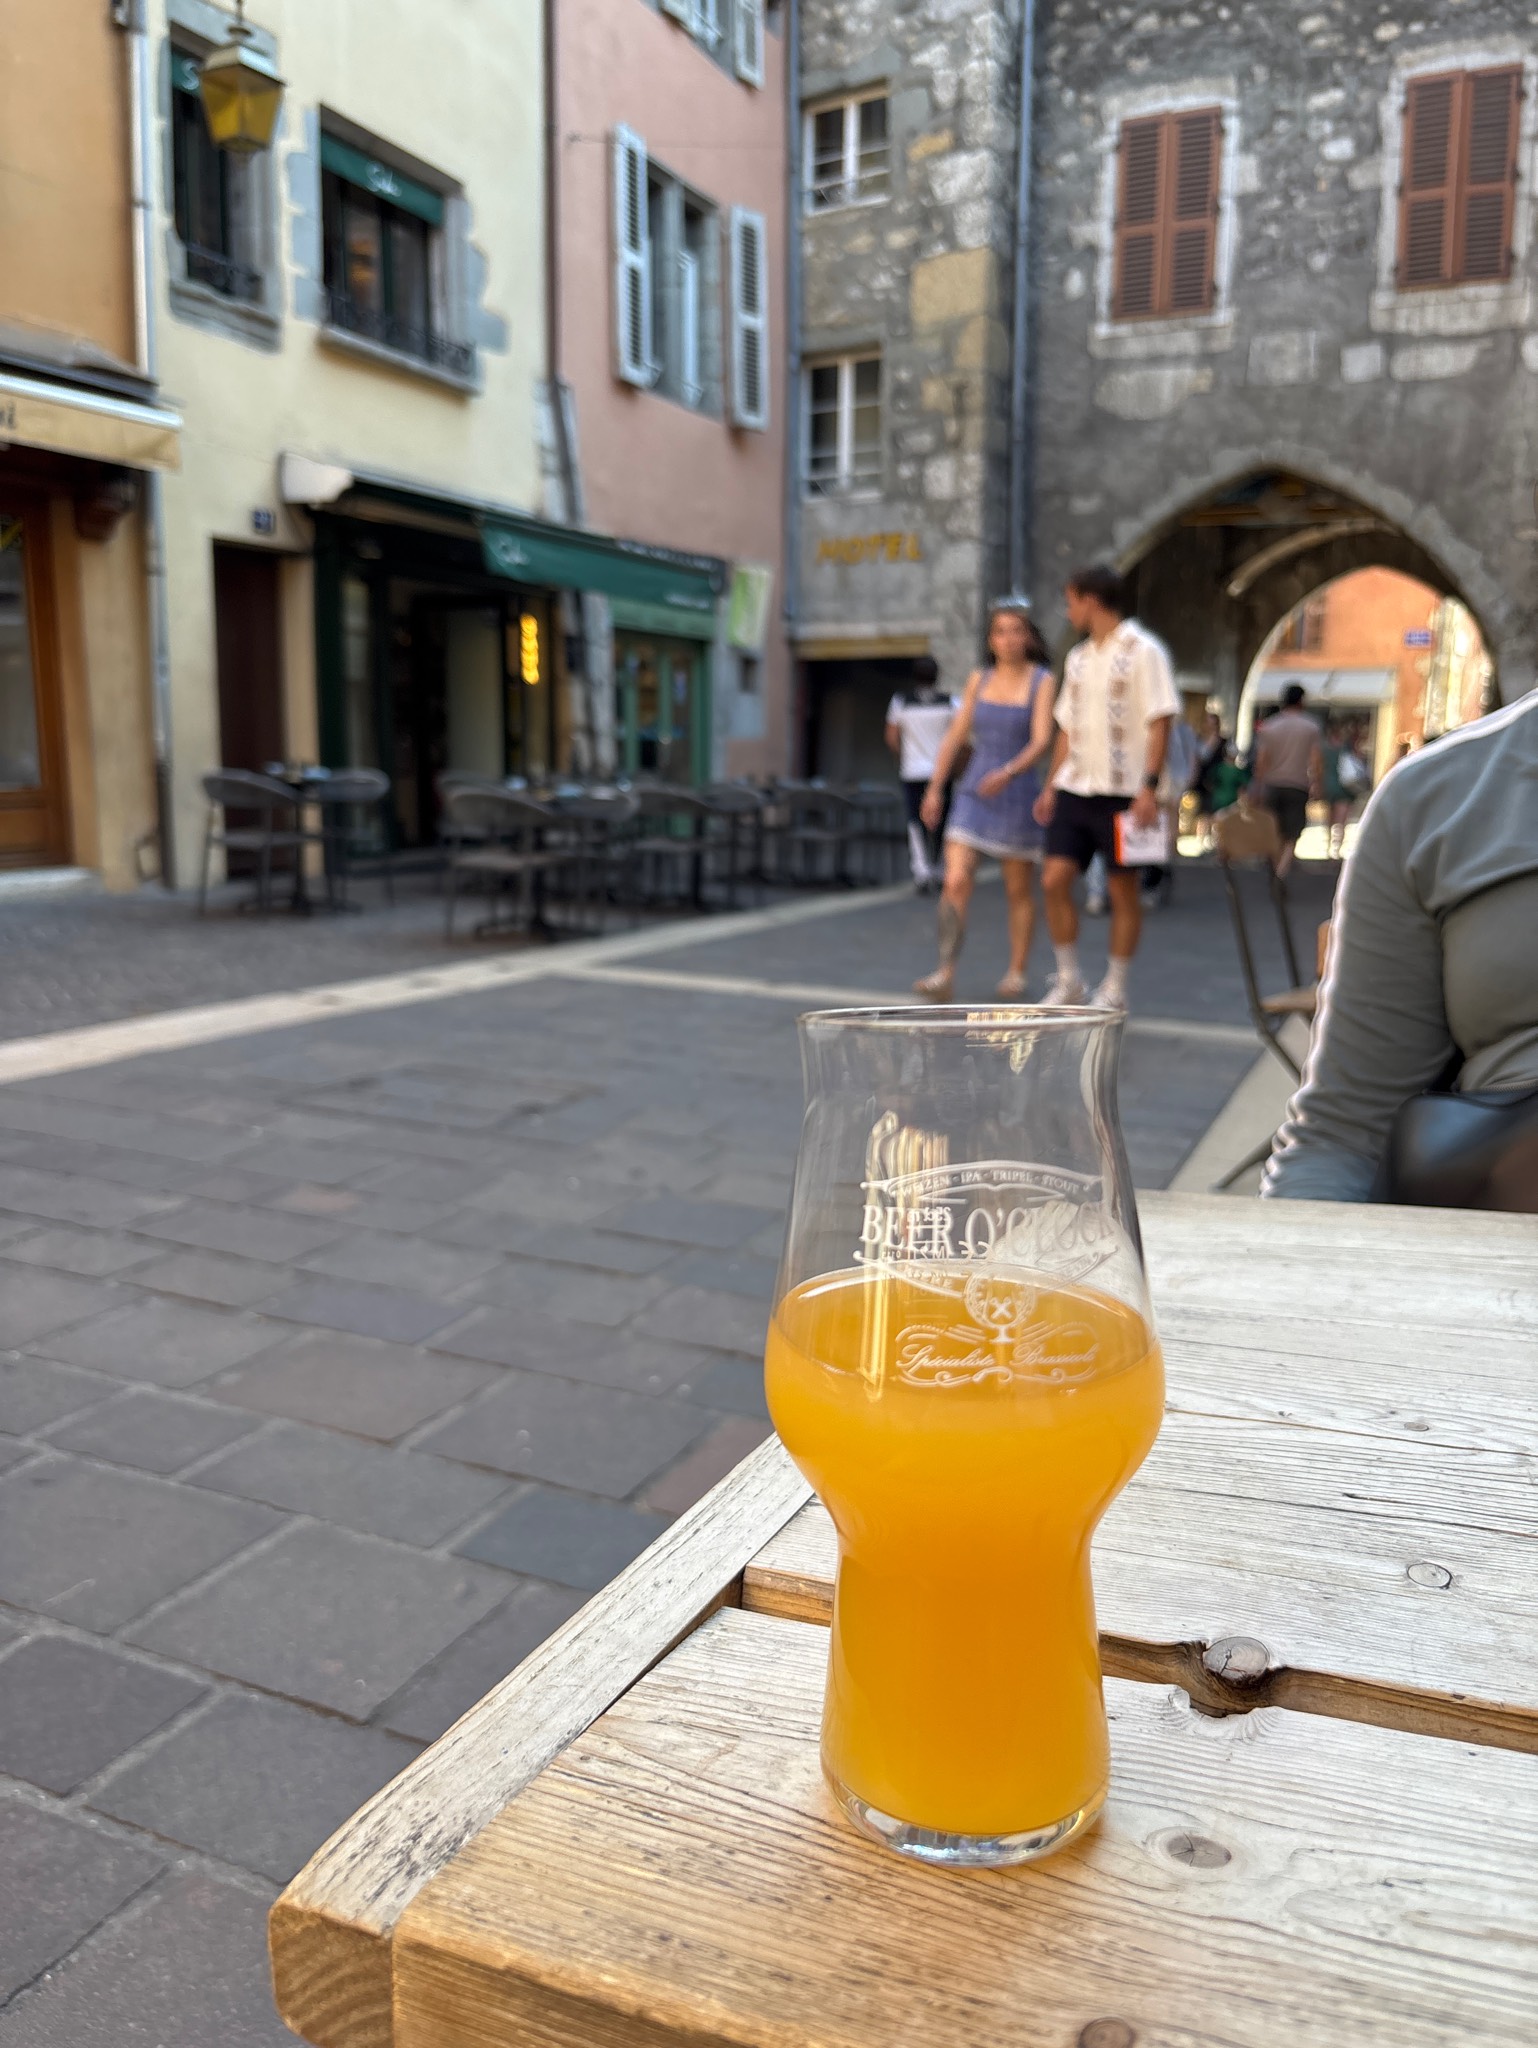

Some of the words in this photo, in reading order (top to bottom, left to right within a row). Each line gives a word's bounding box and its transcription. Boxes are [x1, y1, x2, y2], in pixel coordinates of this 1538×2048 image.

[960, 1171, 981, 1184] IPA
[991, 1170, 1033, 1184] TRIPEL
[1041, 1174, 1080, 1194] STOUT
[859, 1205, 955, 1256] BEER
